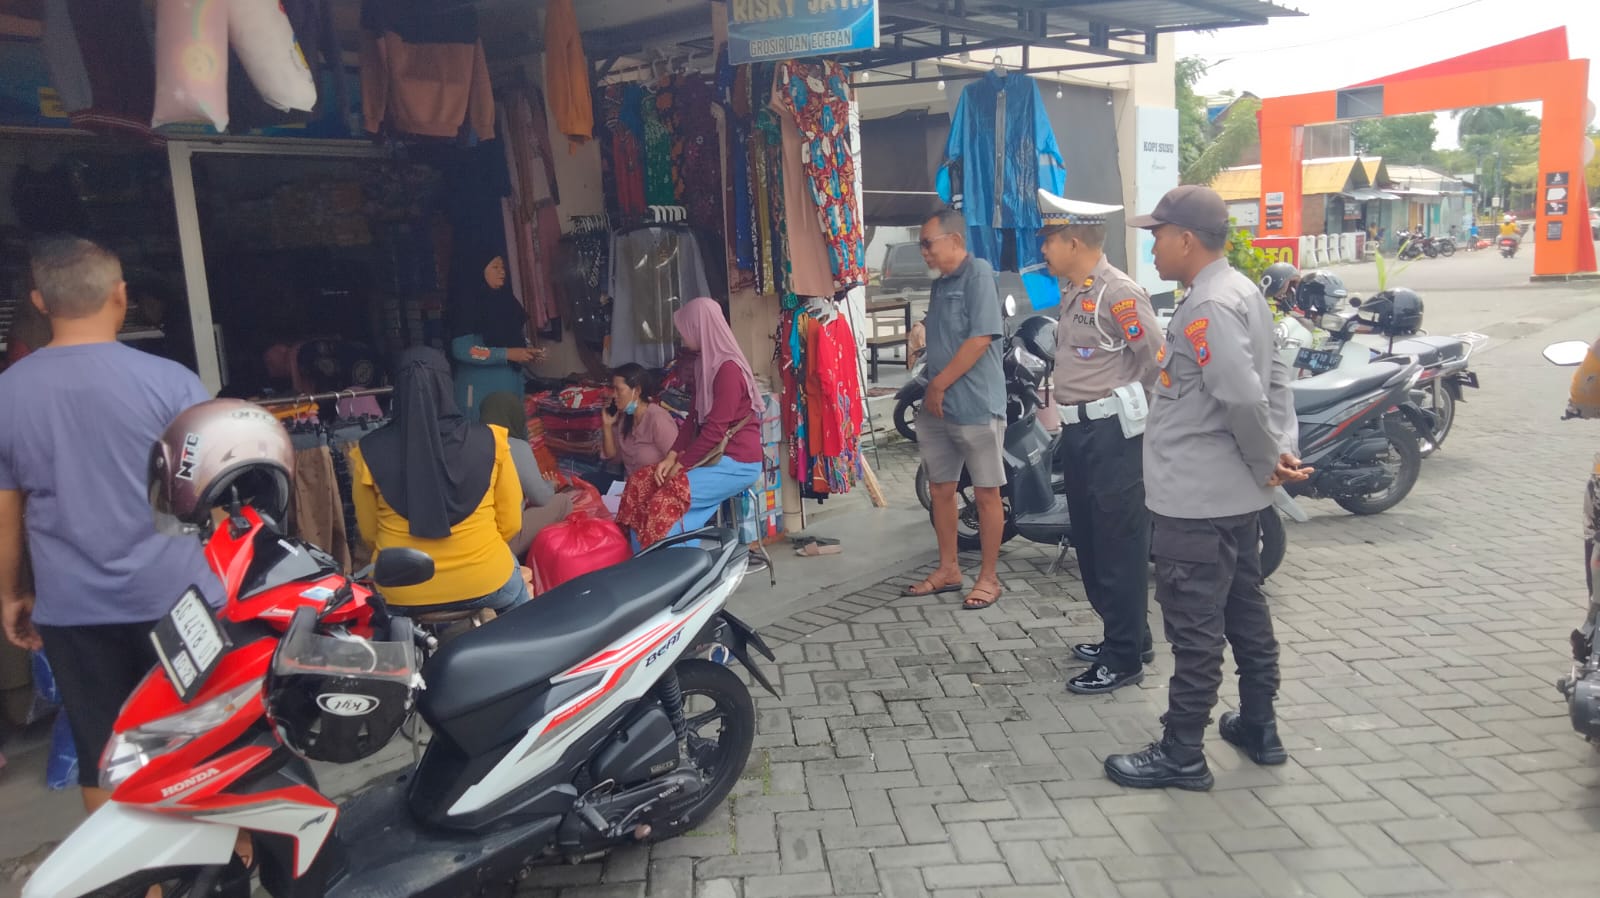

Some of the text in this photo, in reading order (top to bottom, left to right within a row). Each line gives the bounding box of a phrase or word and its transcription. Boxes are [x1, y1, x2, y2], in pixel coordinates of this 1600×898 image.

[733, 0, 795, 22] RISKY
[751, 28, 852, 57] GROSIR DAN ECERAN
[1143, 141, 1175, 153] KOPI SUSU
[1073, 313, 1096, 327] POLR
[178, 433, 200, 480] NTC
[160, 767, 222, 798] HONDA
